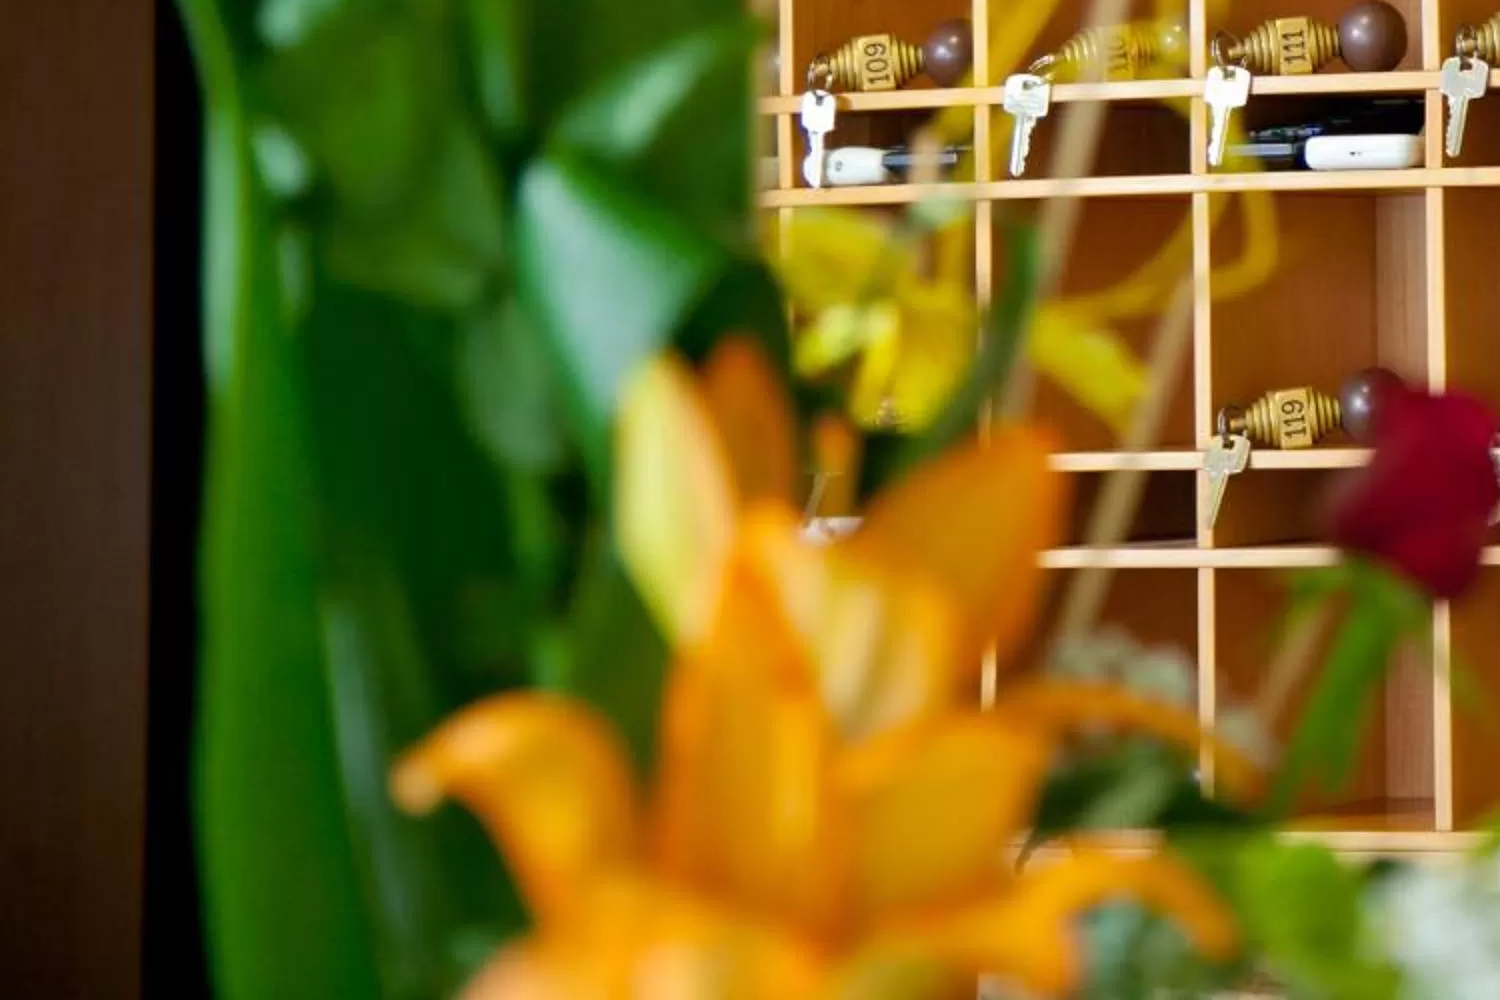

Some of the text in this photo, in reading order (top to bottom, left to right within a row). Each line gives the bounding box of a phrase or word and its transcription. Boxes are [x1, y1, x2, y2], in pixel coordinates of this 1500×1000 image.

[865, 42, 892, 86] 109
[1282, 28, 1307, 64] 111
[1281, 398, 1308, 440] 119
